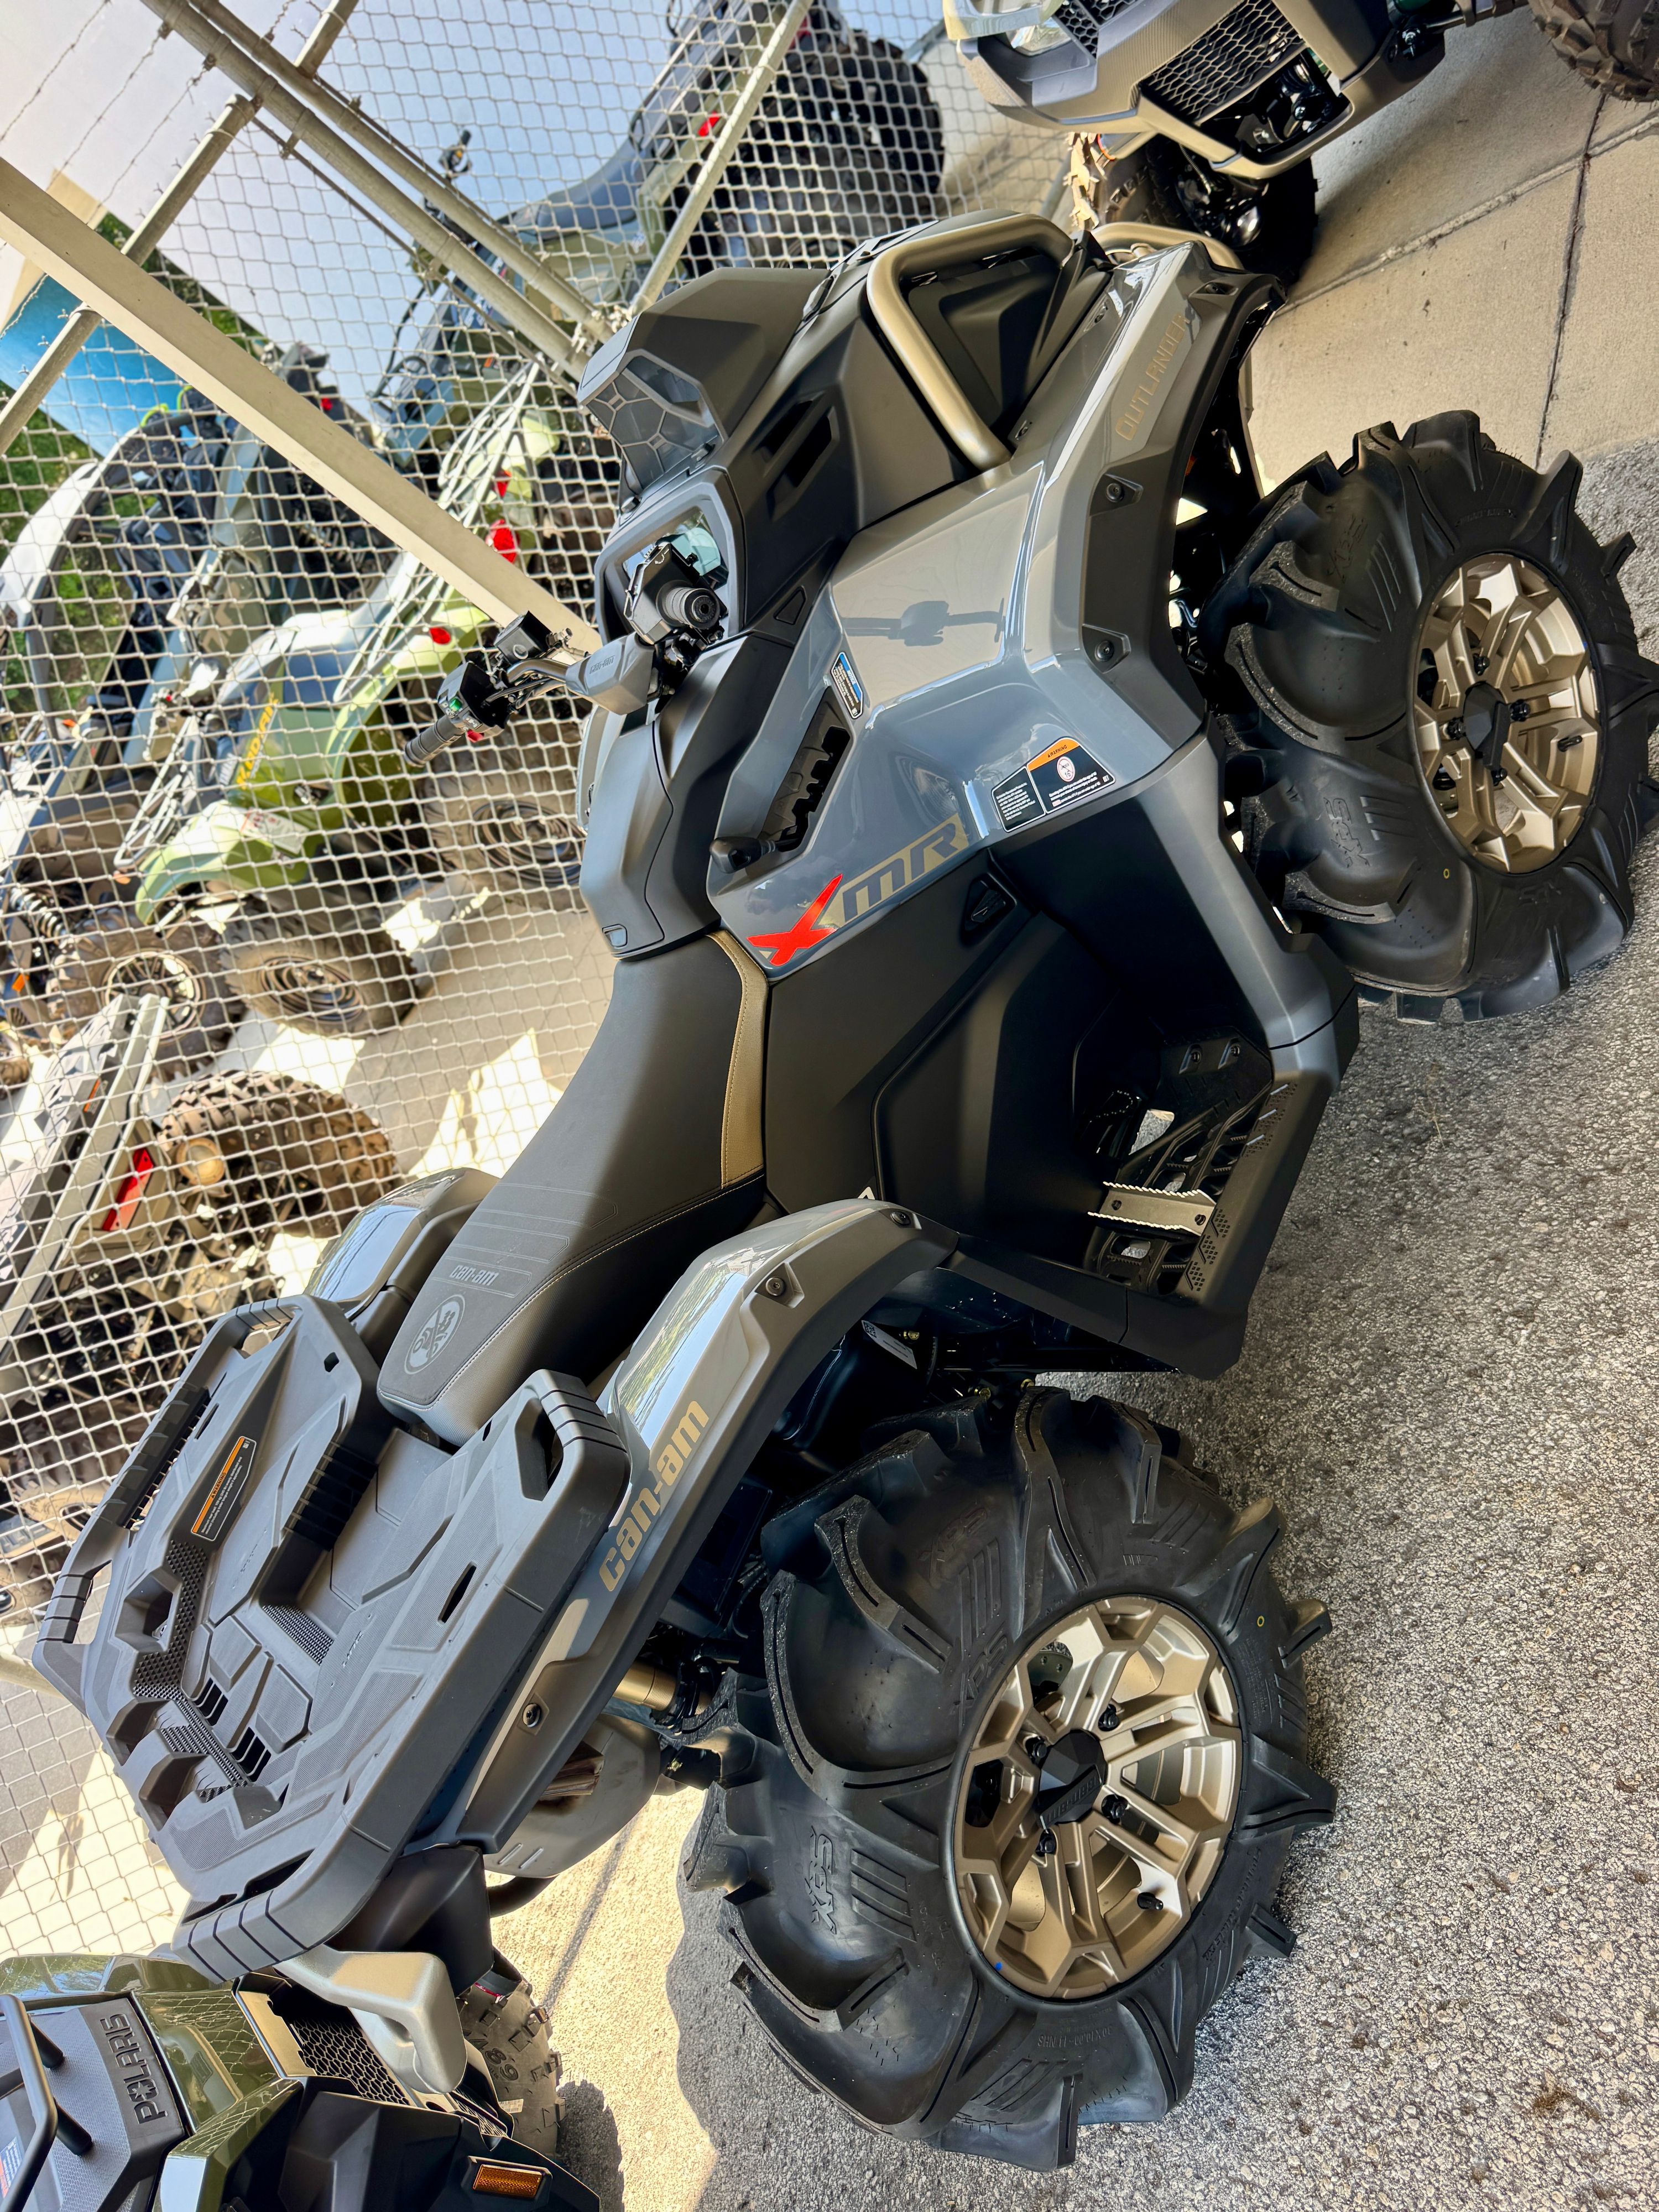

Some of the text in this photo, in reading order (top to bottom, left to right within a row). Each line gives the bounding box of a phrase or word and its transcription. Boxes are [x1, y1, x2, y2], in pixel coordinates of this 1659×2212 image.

[1115, 314, 1190, 441] OUTLANDER
[847, 670, 856, 685] NOTICE
[1050, 744, 1067, 757] WARNING
[448, 1264, 499, 1287] can-am
[212, 1472, 226, 1494] WARNING
[599, 1399, 709, 1593] can-am
[805, 1825, 837, 1935] XPS
[100, 2013, 168, 2125] POLARIS
